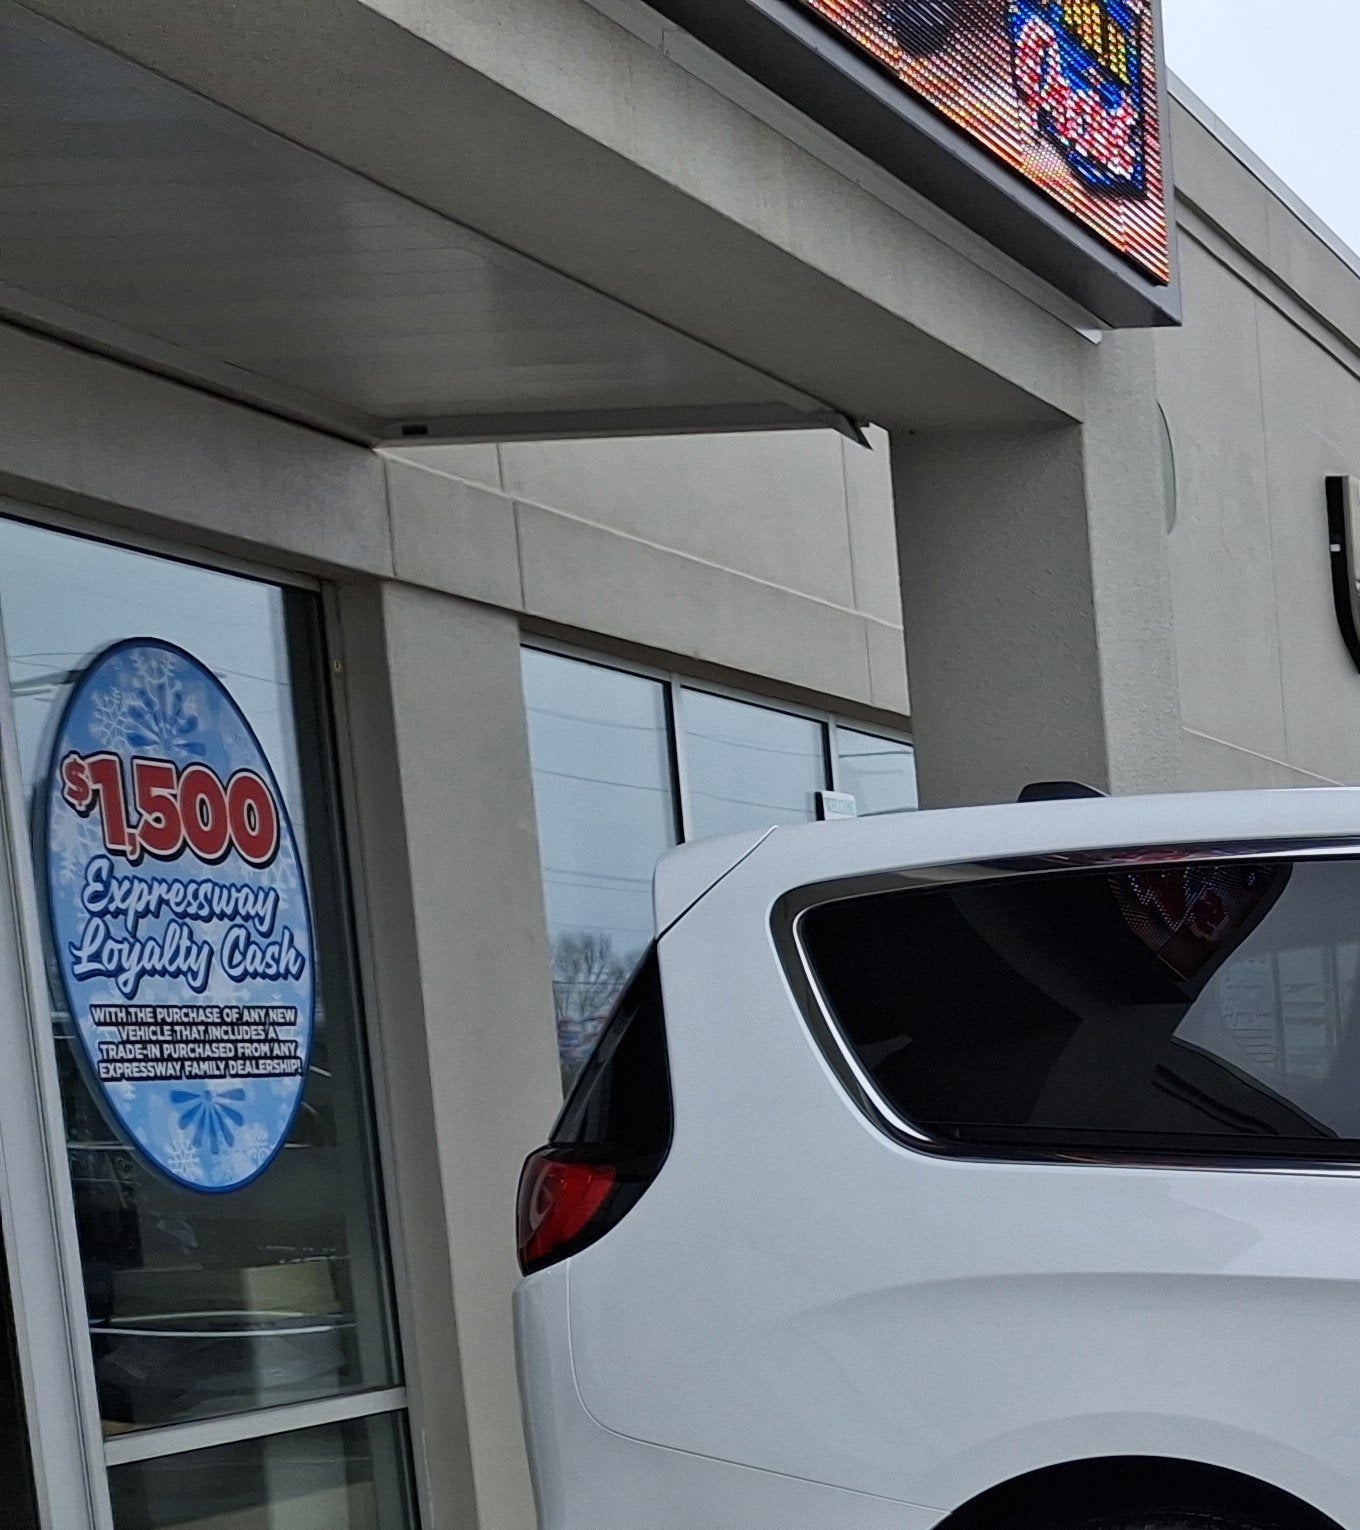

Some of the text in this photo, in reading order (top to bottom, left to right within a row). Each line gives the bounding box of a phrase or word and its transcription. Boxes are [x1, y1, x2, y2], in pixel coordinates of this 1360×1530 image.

[62, 753, 278, 865] $1,500
[84, 856, 278, 936] Expressway
[71, 917, 302, 994] Loyalty Cash
[91, 1006, 295, 1023] WITH THE PURCHASE OF ANY NEW
[119, 1025, 277, 1041] VEHICLE THAT INCLUDES A
[100, 1042, 296, 1060] TRADE-IN PURCHASED FROM ANY
[100, 1061, 182, 1079] EXPRESSWAY
[184, 1060, 226, 1077] FAMILY
